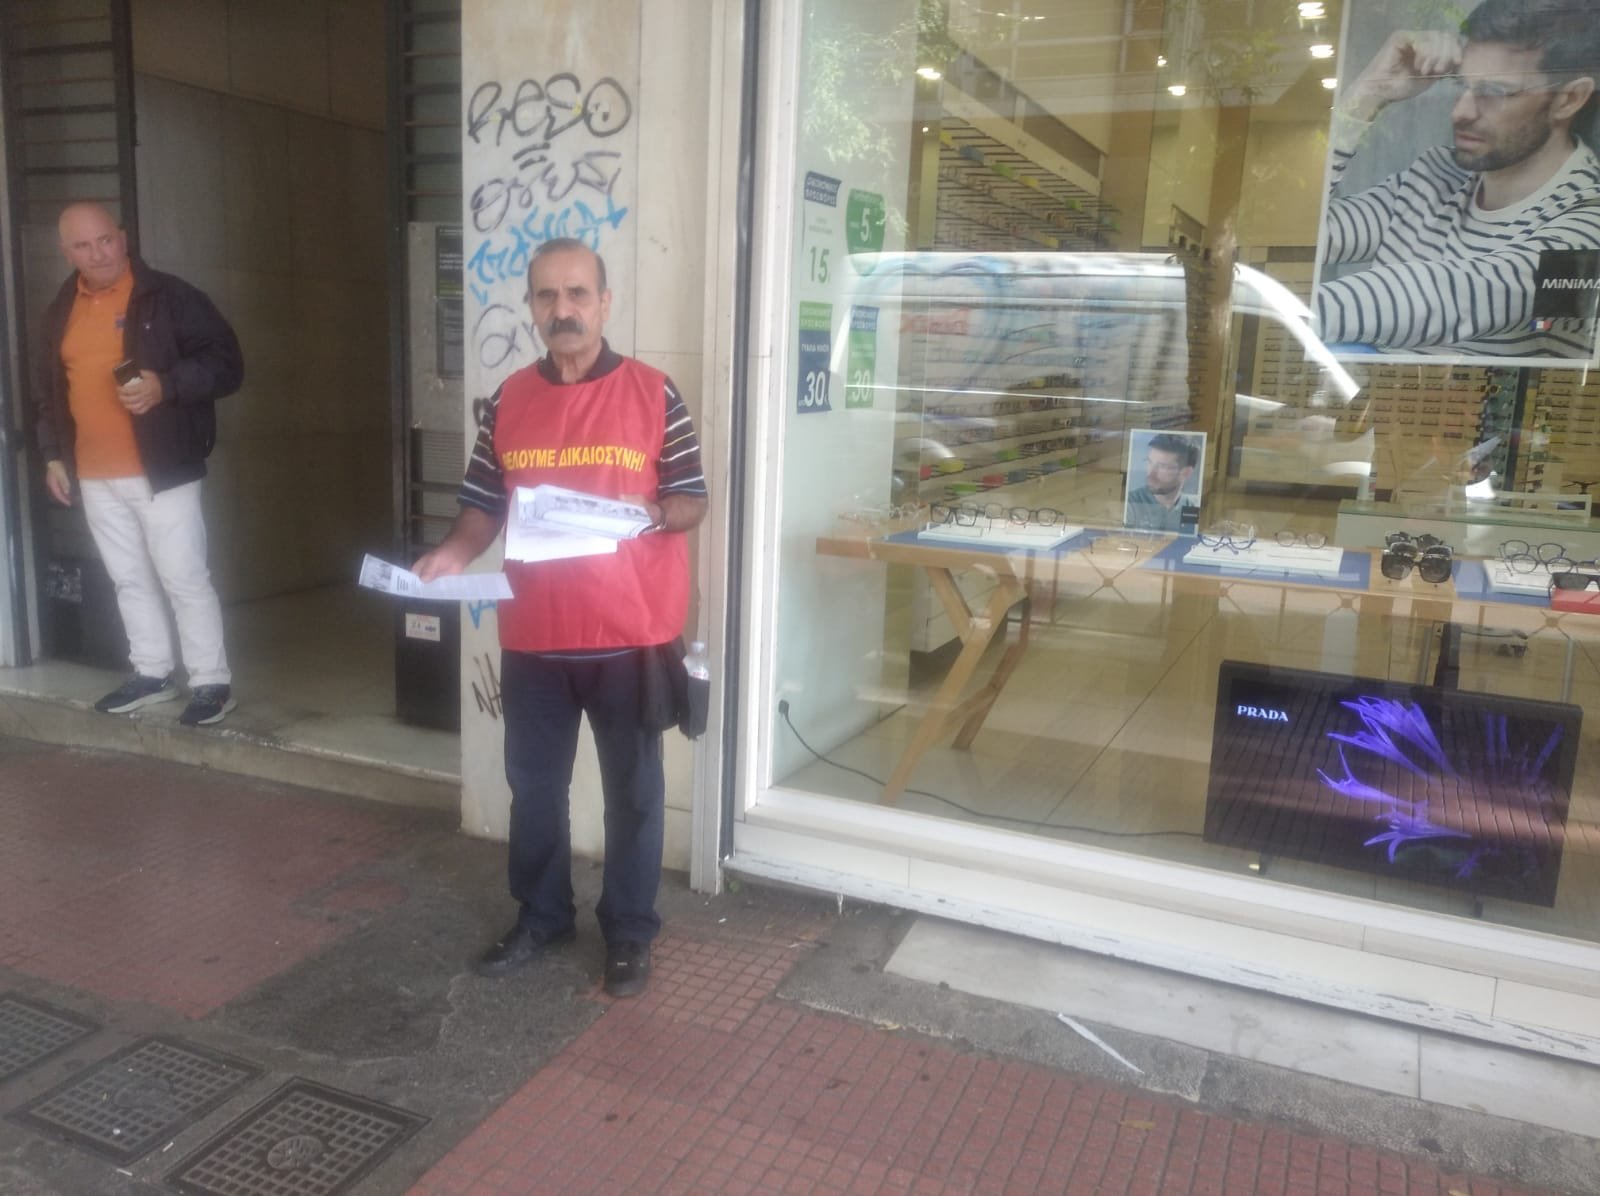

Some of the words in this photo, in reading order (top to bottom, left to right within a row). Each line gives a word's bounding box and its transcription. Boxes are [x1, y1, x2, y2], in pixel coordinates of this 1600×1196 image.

[810, 246, 830, 283] 15
[558, 445, 646, 472] ΔΙΚΑΙΟΣΥΝΗ!
[1237, 704, 1289, 722] PRADA
